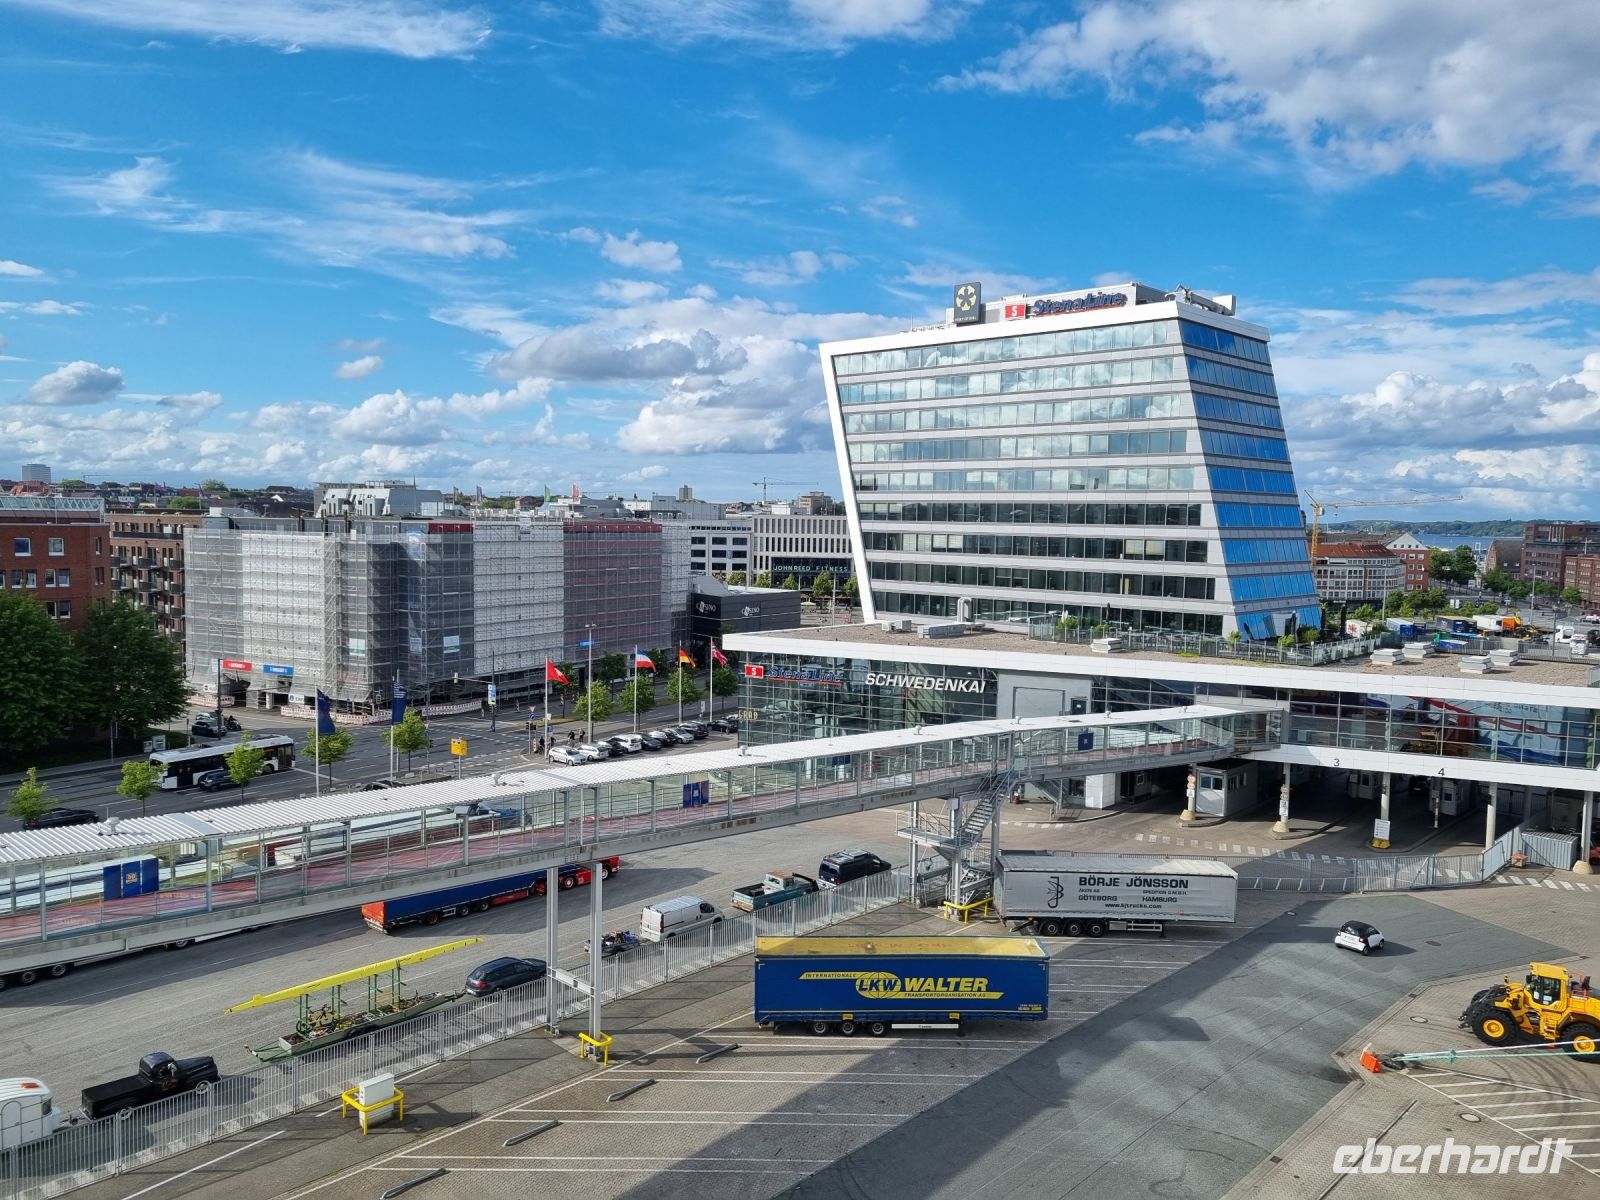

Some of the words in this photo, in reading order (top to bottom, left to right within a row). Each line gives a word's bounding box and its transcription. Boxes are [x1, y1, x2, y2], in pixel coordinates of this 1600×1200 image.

[865, 673, 986, 693] SCHWEDENKAI
[1333, 758, 1340, 767] 3
[1438, 767, 1445, 777] 4
[1079, 875, 1120, 887] BÖRJE
[1126, 876, 1189, 888] JÖNSSON
[1078, 894, 1118, 902] GÖTEBORG
[858, 979, 899, 992] LKW
[904, 977, 989, 992] WALTER
